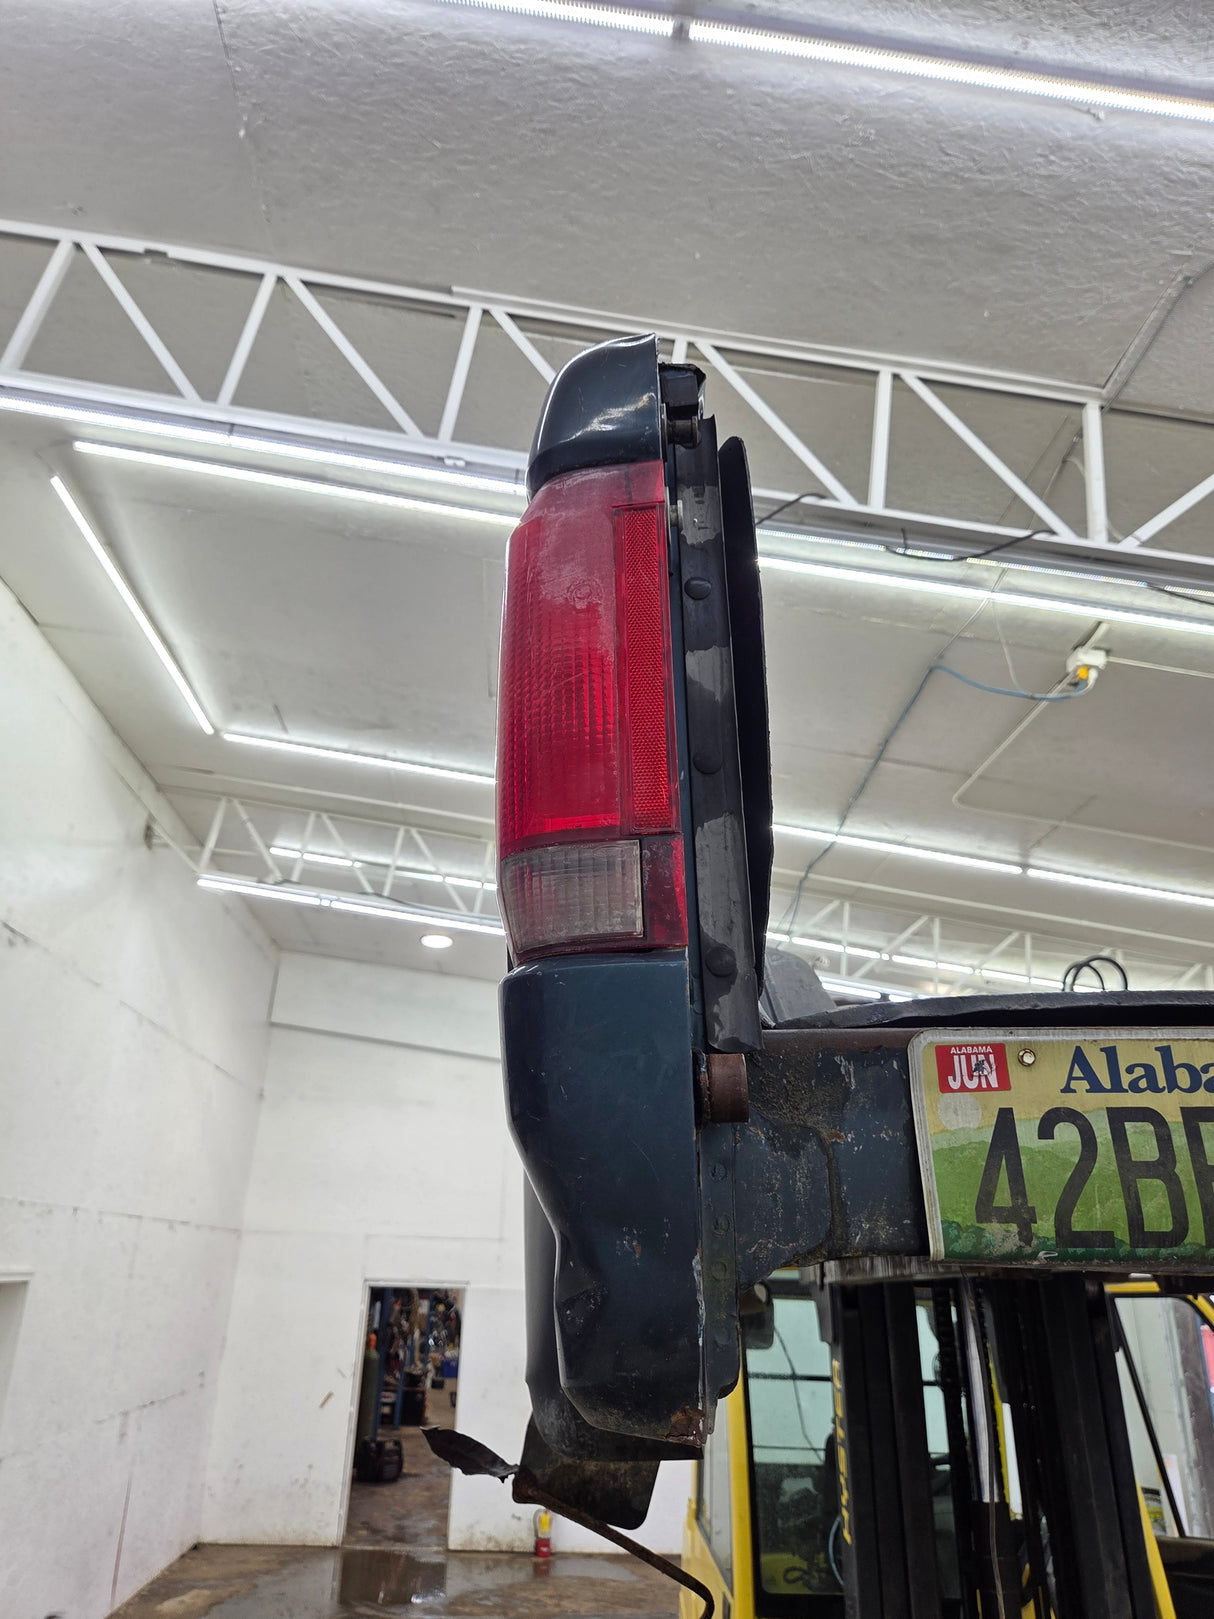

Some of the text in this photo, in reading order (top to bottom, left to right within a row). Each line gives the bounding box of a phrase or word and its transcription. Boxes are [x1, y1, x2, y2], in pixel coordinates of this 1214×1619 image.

[950, 1046, 993, 1054] ALABAMA
[947, 1054, 999, 1090] JUN
[832, 1358, 852, 1545] HYSTER
